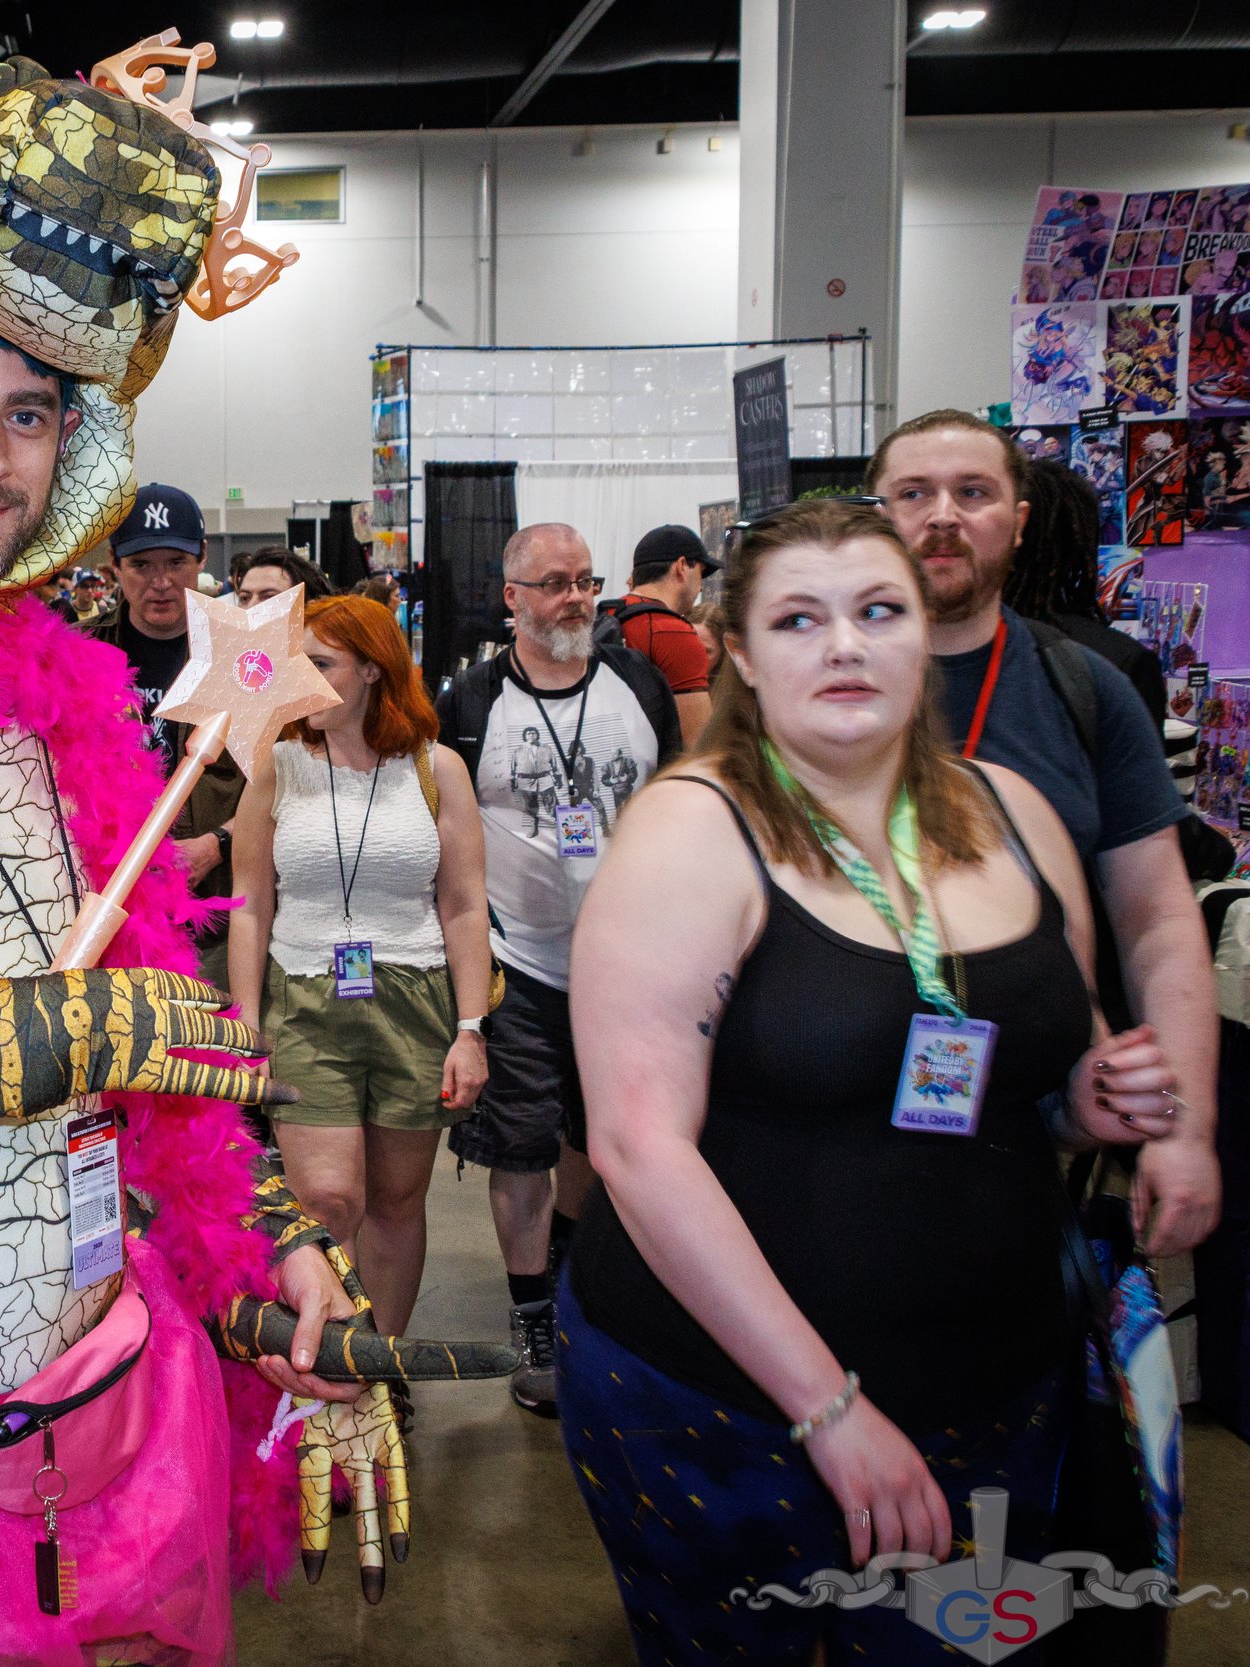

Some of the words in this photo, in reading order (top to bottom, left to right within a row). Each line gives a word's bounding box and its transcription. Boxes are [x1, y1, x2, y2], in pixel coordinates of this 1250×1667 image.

[144, 502, 170, 529] NY
[899, 1111, 924, 1124] ALL
[928, 1114, 964, 1127] DAYS
